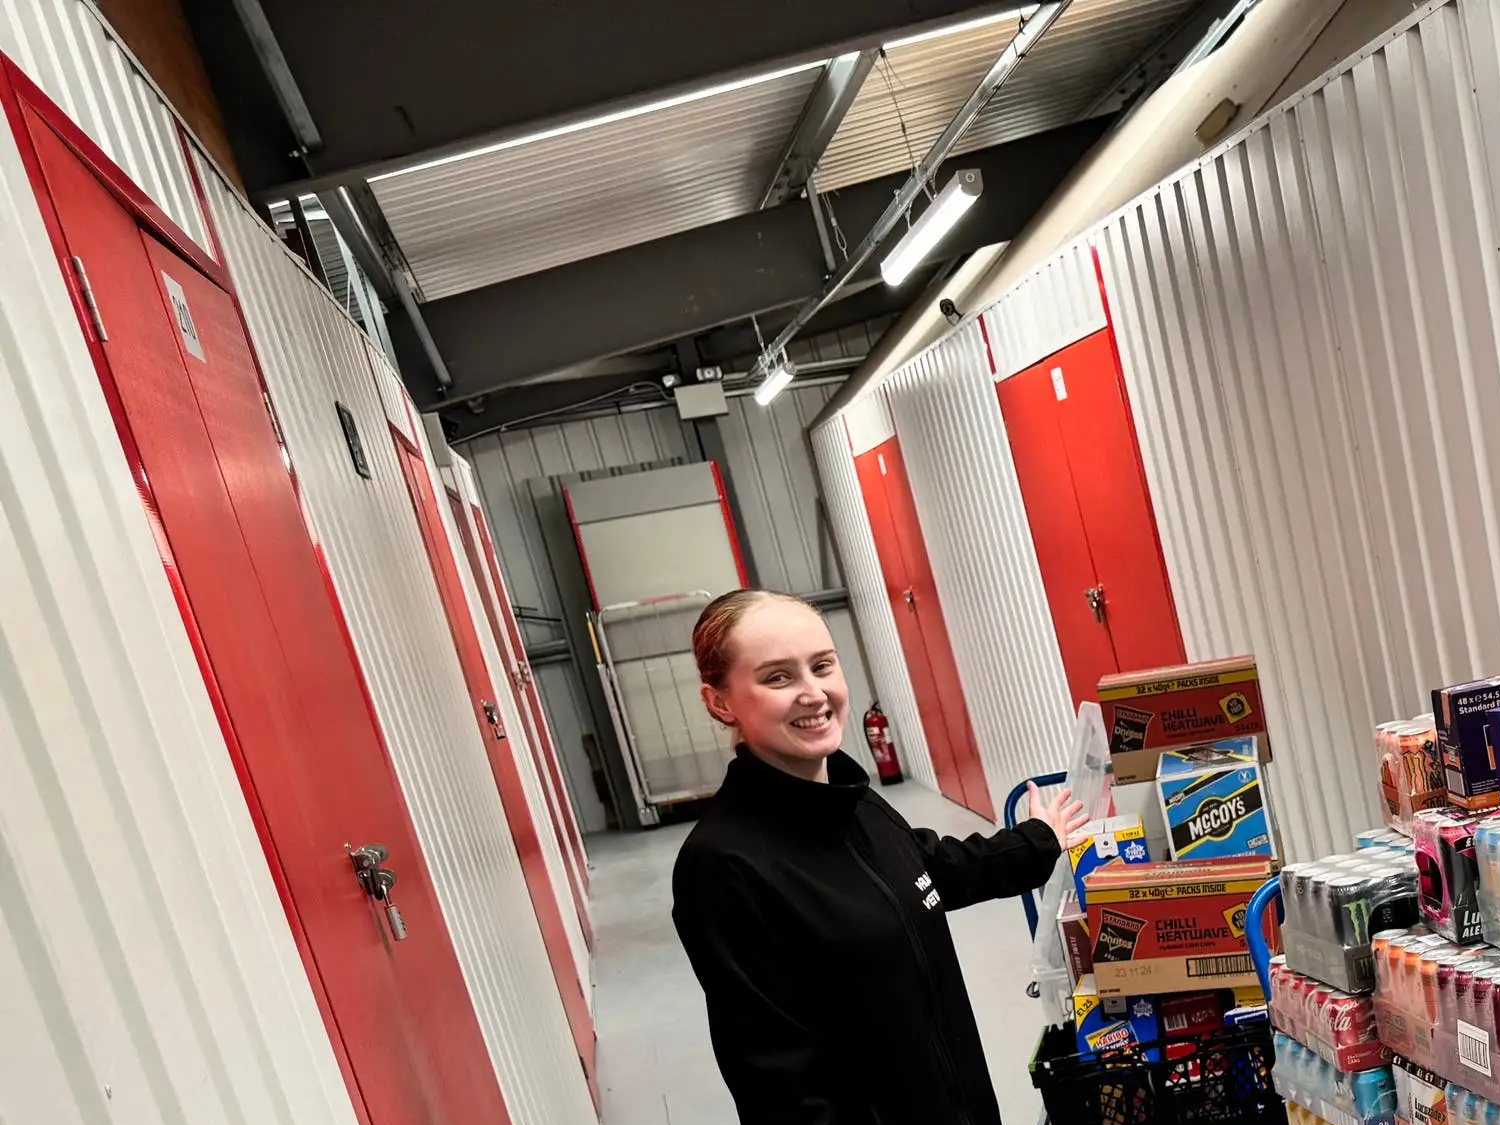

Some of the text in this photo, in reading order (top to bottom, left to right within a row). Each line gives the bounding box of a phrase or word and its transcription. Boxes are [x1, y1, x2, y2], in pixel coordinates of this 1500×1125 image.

[1457, 697, 1467, 706] 48
[1482, 691, 1500, 701] 54.5
[1161, 707, 1197, 722] CHILLI
[1459, 702, 1495, 715] Standard
[1162, 714, 1226, 733] HEATWAVE
[1129, 889, 1140, 899] 32
[1142, 890, 1148, 898] x
[1176, 885, 1200, 896] PACKS
[1201, 883, 1226, 894] INSIDE
[1103, 913, 1141, 931] STANDARD
[1155, 917, 1197, 931] CHILLI
[1156, 926, 1229, 943] HEATWAVE
[1076, 999, 1093, 1017] £1.25
[1095, 1028, 1129, 1047] HARIBO
